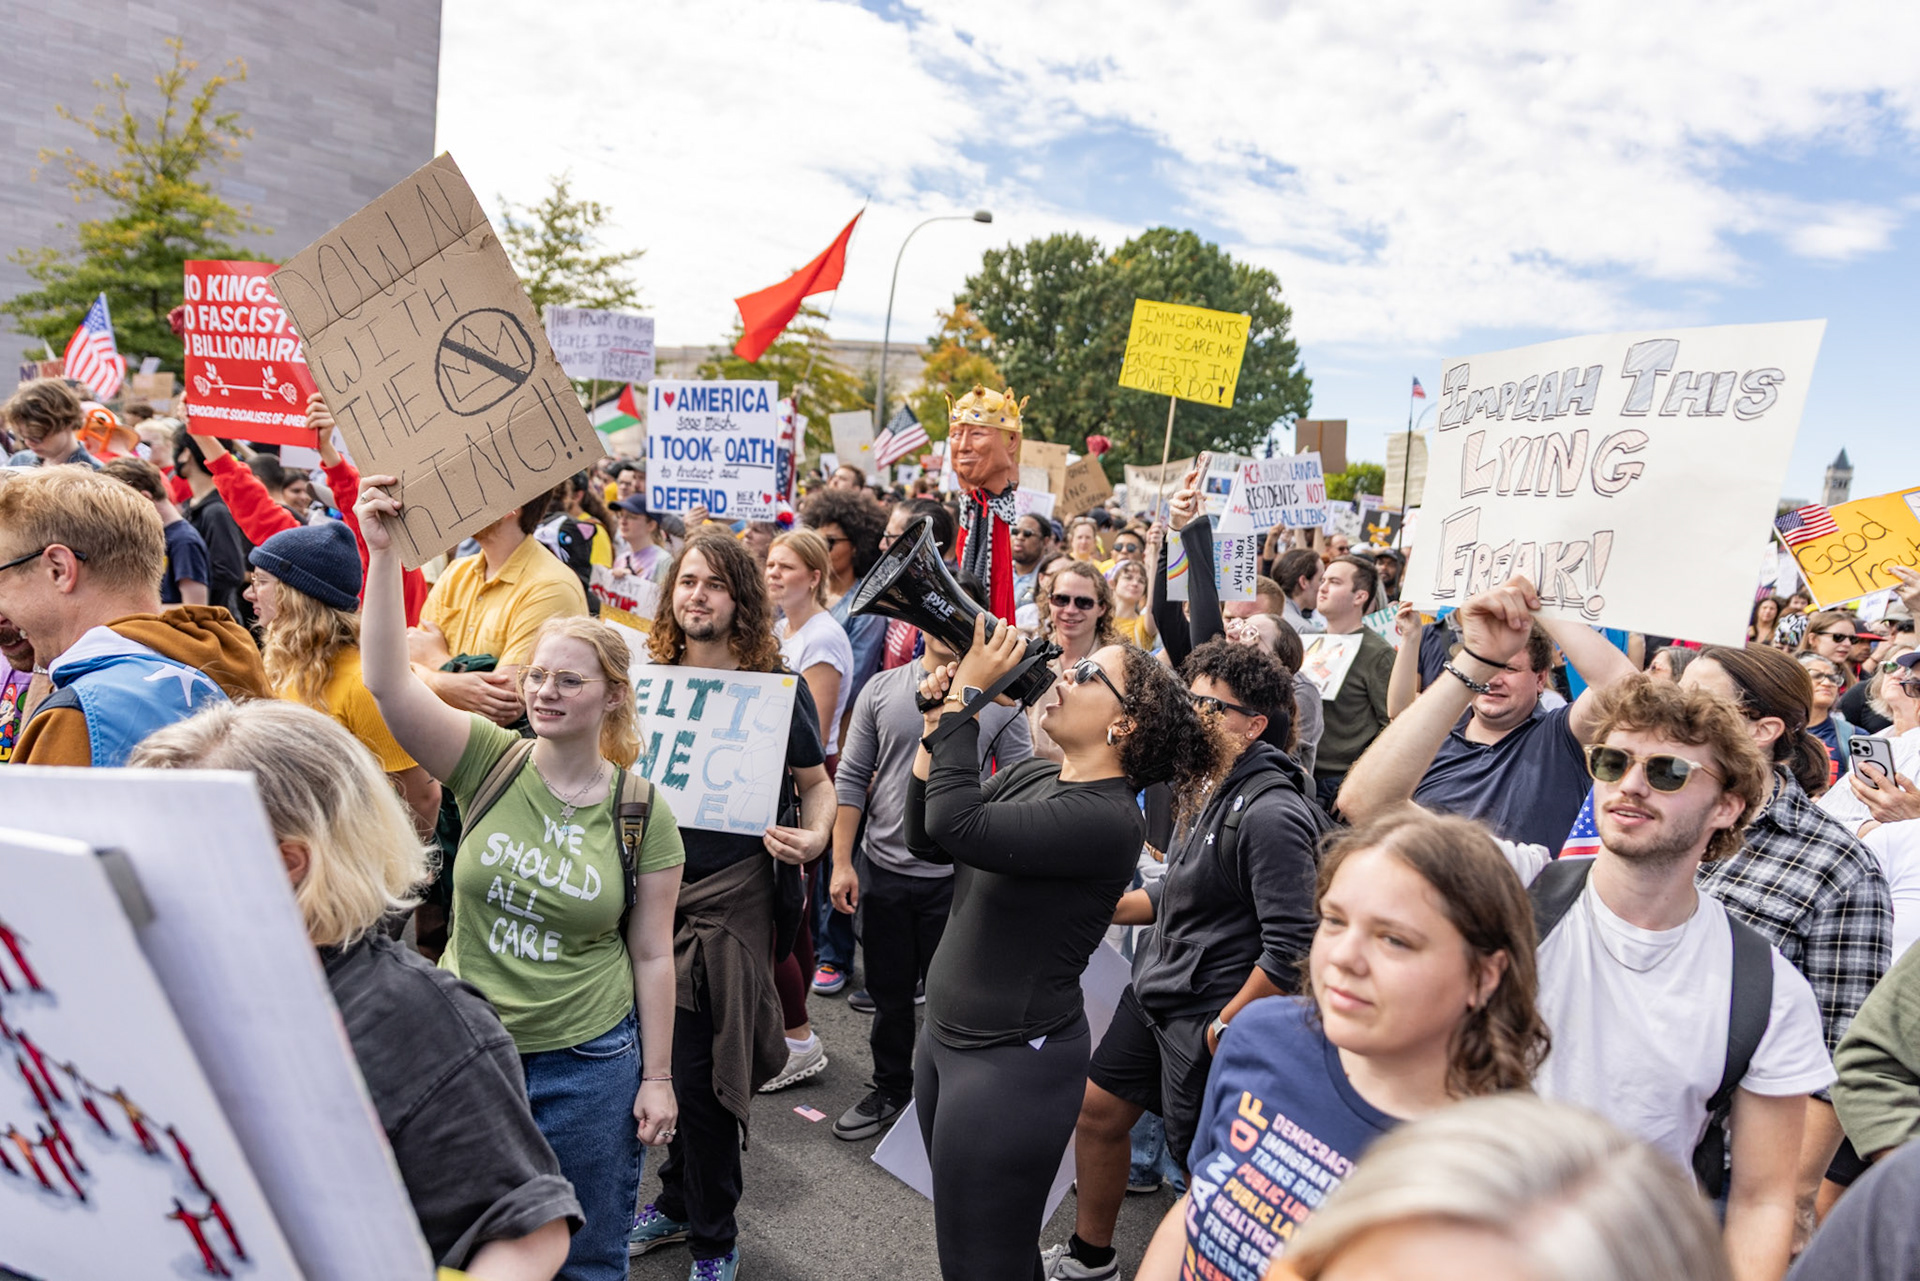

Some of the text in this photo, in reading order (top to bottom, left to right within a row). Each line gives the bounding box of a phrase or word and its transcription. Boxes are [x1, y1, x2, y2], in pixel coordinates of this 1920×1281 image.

[271, 173, 470, 349] DOWN
[319, 278, 460, 396] WITH
[1140, 305, 1242, 340] IMMIGRANTS
[191, 333, 307, 364] BILLIONAIRE
[1126, 344, 1236, 385] FASCISTS IN
[1174, 333, 1215, 357] SCARE
[1217, 343, 1240, 360] ME
[654, 386, 770, 413] I AMERICA
[1123, 364, 1182, 397] POWER
[229, 408, 273, 425] SOCIALISTS
[283, 413, 307, 428] AMER
[336, 362, 441, 461] THE
[649, 435, 653, 459] I
[660, 435, 713, 462] TOOK
[724, 437, 774, 464] OATH
[653, 485, 727, 514] DEFEND
[1245, 483, 1299, 510] RESIDENTS
[1306, 483, 1324, 503] NOT
[1233, 539, 1245, 593] FOR THAT
[1245, 534, 1255, 584] WAITING
[635, 678, 726, 721] ELT
[543, 814, 586, 856] WE
[480, 832, 602, 901] SHOULD
[486, 875, 545, 923] ALL
[488, 916, 563, 962] CARE
[1250, 1146, 1326, 1209] TRANS RIG
[1261, 1131, 1342, 1193] IMMIGRANT
[1223, 1176, 1296, 1241] PUBLIC LA
[1236, 1162, 1312, 1224] PUBLIC LIB
[1203, 1211, 1271, 1277] FREE SPE
[1212, 1192, 1286, 1261] HEALTHCA
